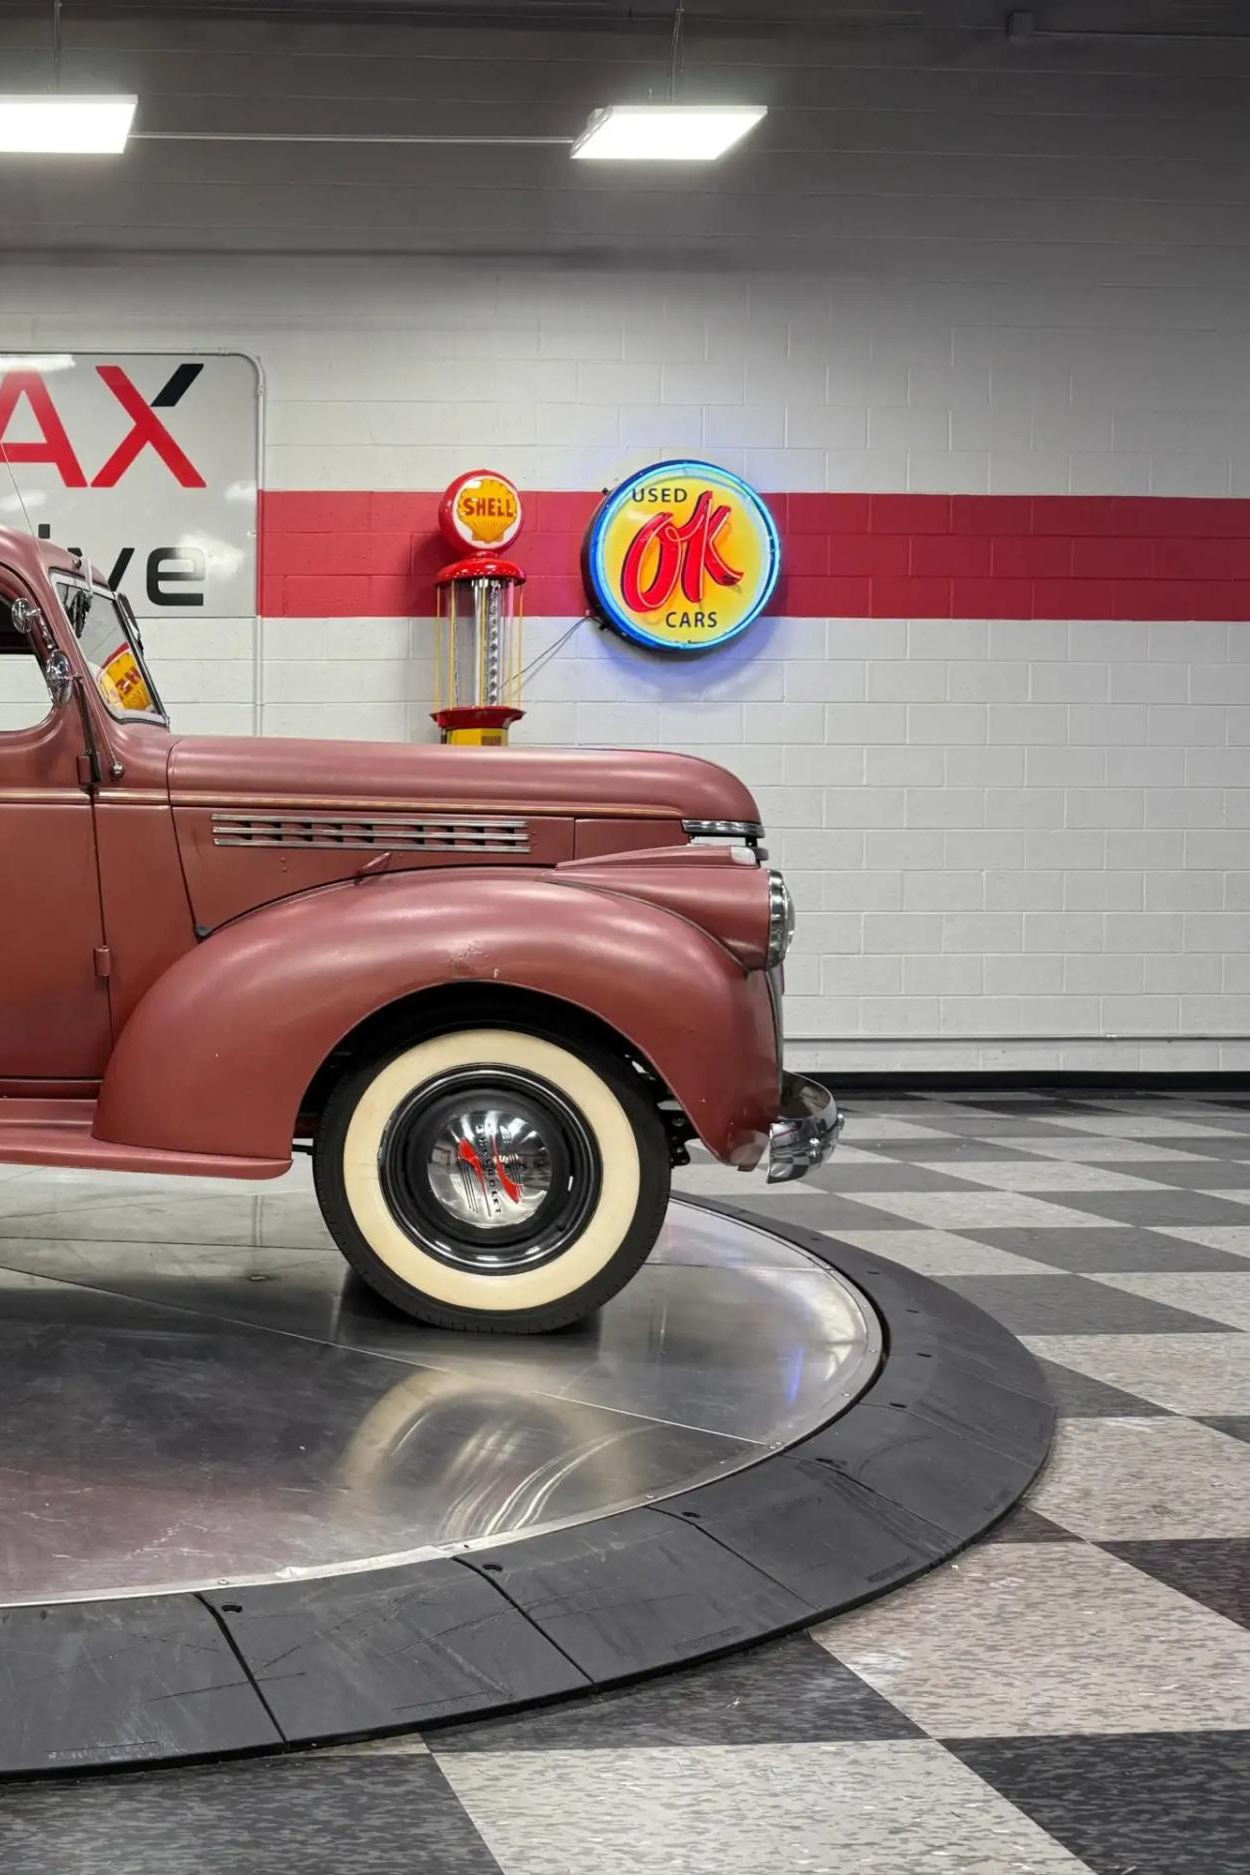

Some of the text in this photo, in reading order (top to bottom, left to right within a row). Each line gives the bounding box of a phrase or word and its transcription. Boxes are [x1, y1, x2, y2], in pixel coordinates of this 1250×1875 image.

[632, 488, 687, 503] USED
[463, 497, 514, 517] SHELL
[620, 490, 744, 612] OK
[665, 611, 718, 628] CARS
